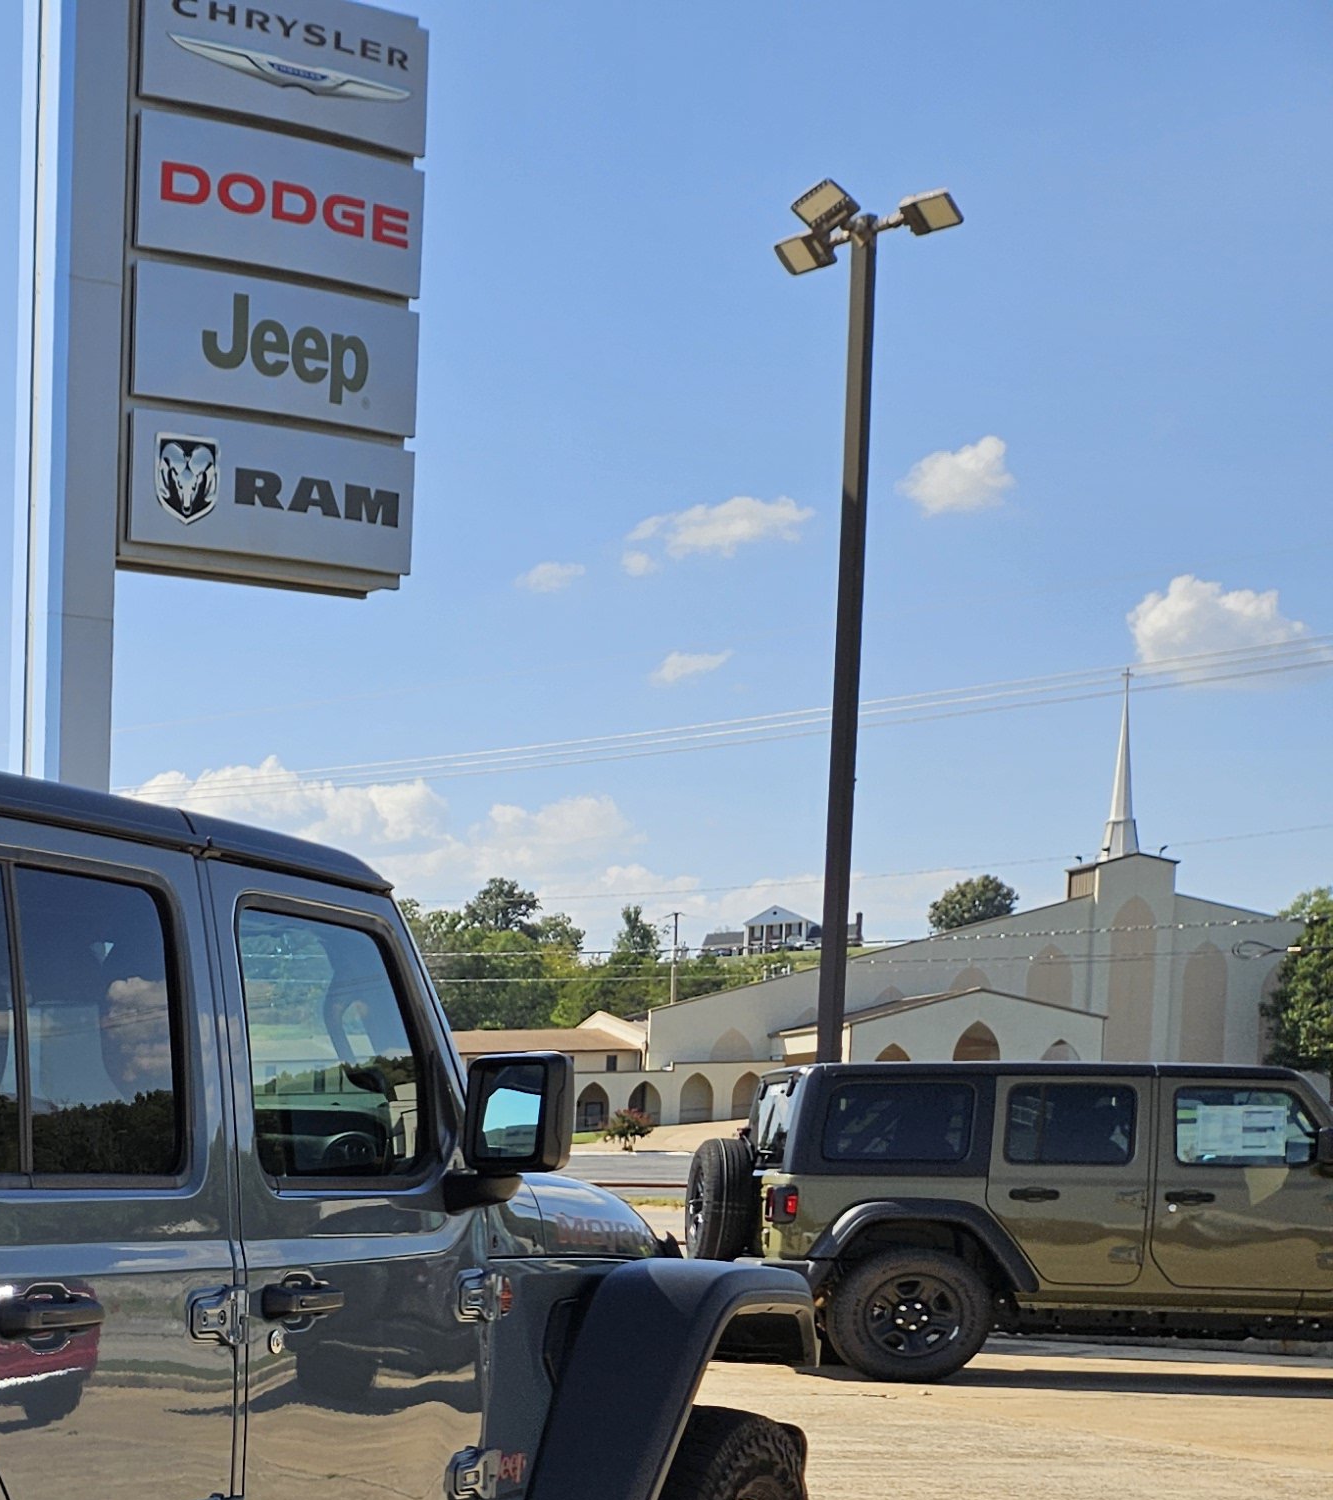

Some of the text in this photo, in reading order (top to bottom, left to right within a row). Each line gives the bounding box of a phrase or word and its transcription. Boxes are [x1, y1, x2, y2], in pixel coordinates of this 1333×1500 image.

[171, 0, 410, 71] CHRYSLER
[160, 160, 410, 249] DODGE
[201, 293, 369, 404] Jeep
[234, 467, 400, 528] RAM
